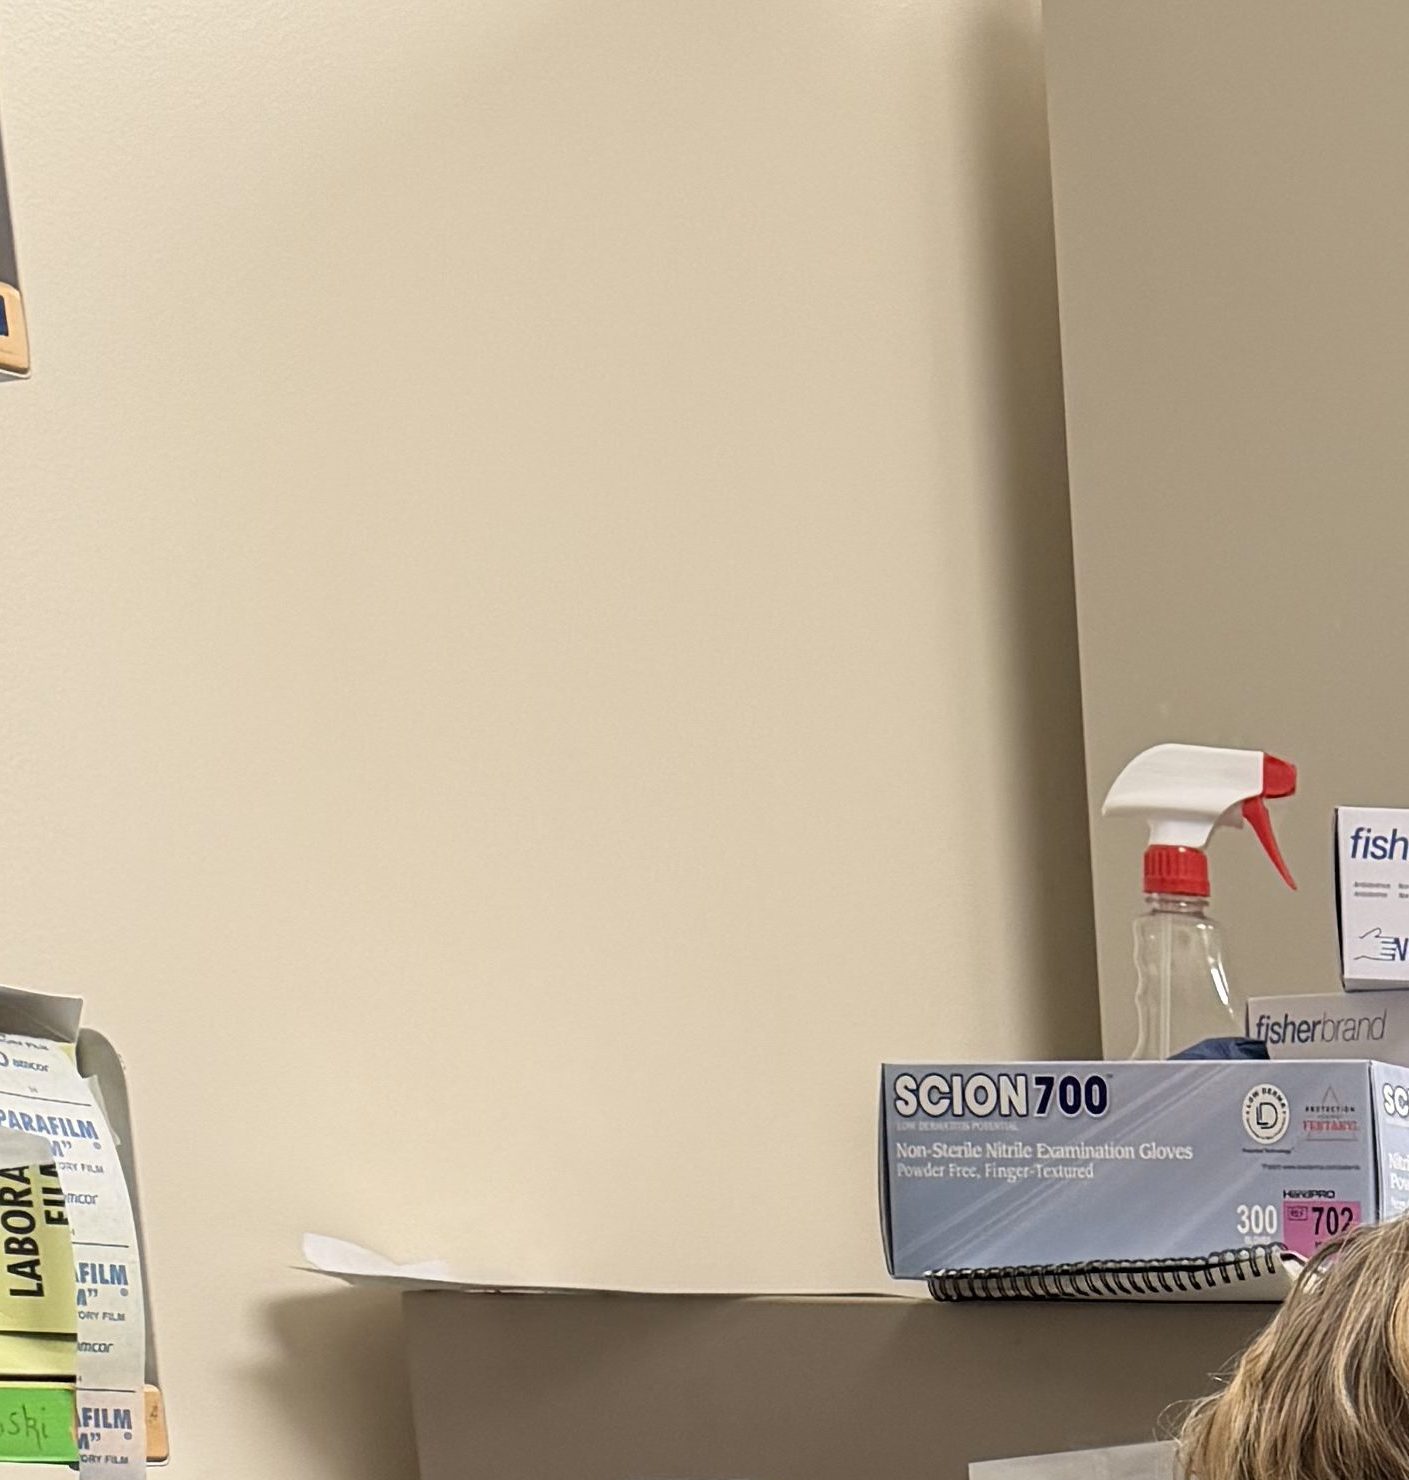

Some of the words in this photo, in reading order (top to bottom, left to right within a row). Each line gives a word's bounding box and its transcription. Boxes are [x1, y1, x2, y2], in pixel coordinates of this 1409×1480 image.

[1255, 1008, 1387, 1044] fisherbrand
[897, 1142, 983, 1159] Non-Sterile
[986, 1141, 1032, 1159] Nitrile
[1036, 1142, 1135, 1160] Examination
[1138, 1143, 1193, 1161] Gloves
[80, 1164, 104, 1174] FILM
[897, 1163, 945, 1178] Powder
[949, 1163, 981, 1179] Free,
[984, 1162, 1094, 1183] Finger-Textured
[1236, 1204, 1278, 1234] 300
[1311, 1206, 1354, 1236] 702
[102, 1312, 126, 1322] FILM
[104, 1455, 129, 1465] FILM
